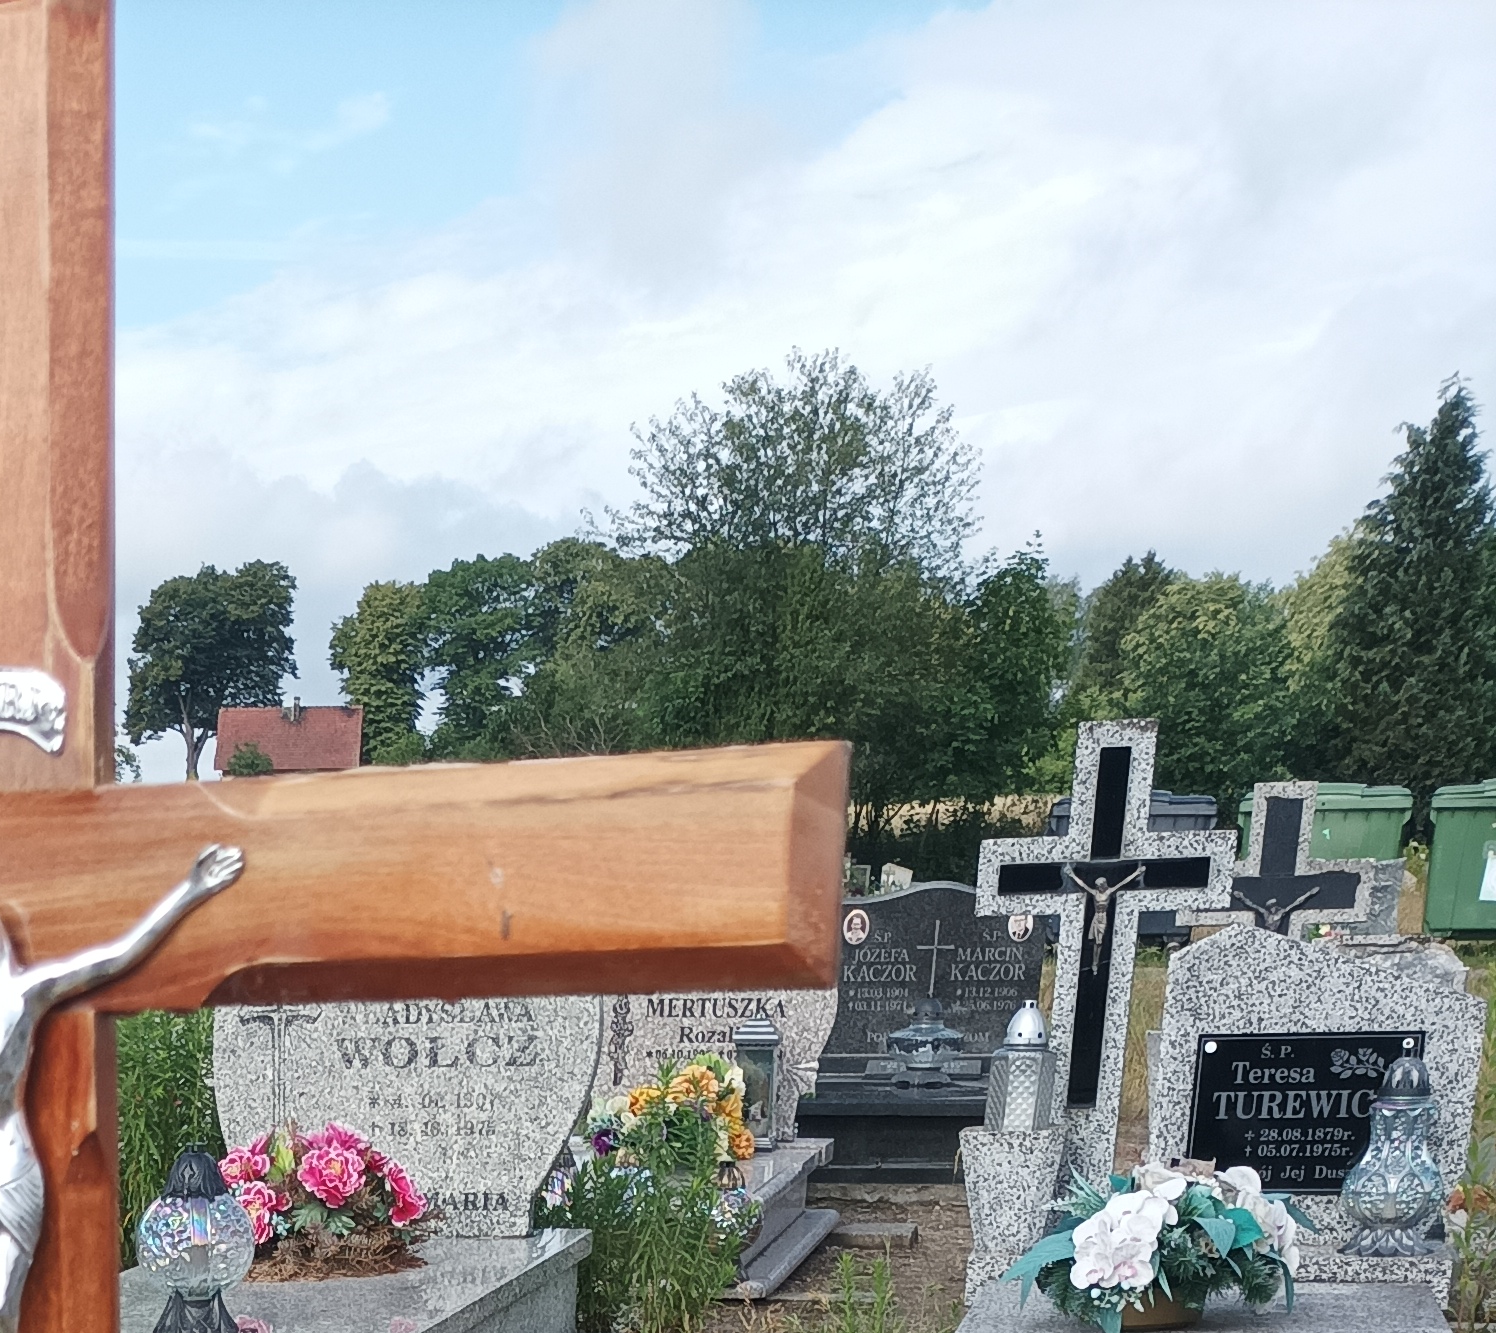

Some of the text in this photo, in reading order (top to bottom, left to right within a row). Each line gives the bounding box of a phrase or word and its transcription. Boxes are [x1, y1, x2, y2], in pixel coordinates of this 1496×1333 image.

[853, 948, 909, 964] JÓZEFA
[957, 947, 1023, 961] MARCIN
[843, 964, 917, 982] KACZOR
[950, 963, 1026, 981] KACZOR
[646, 998, 787, 1018] MERTUSZKA
[1232, 1061, 1315, 1084] Teresa
[1259, 1128, 1356, 1141] 28.08.1879r.
[1258, 1144, 1354, 1157] 05.07.1975r.
[1280, 1165, 1305, 1181] Jej
